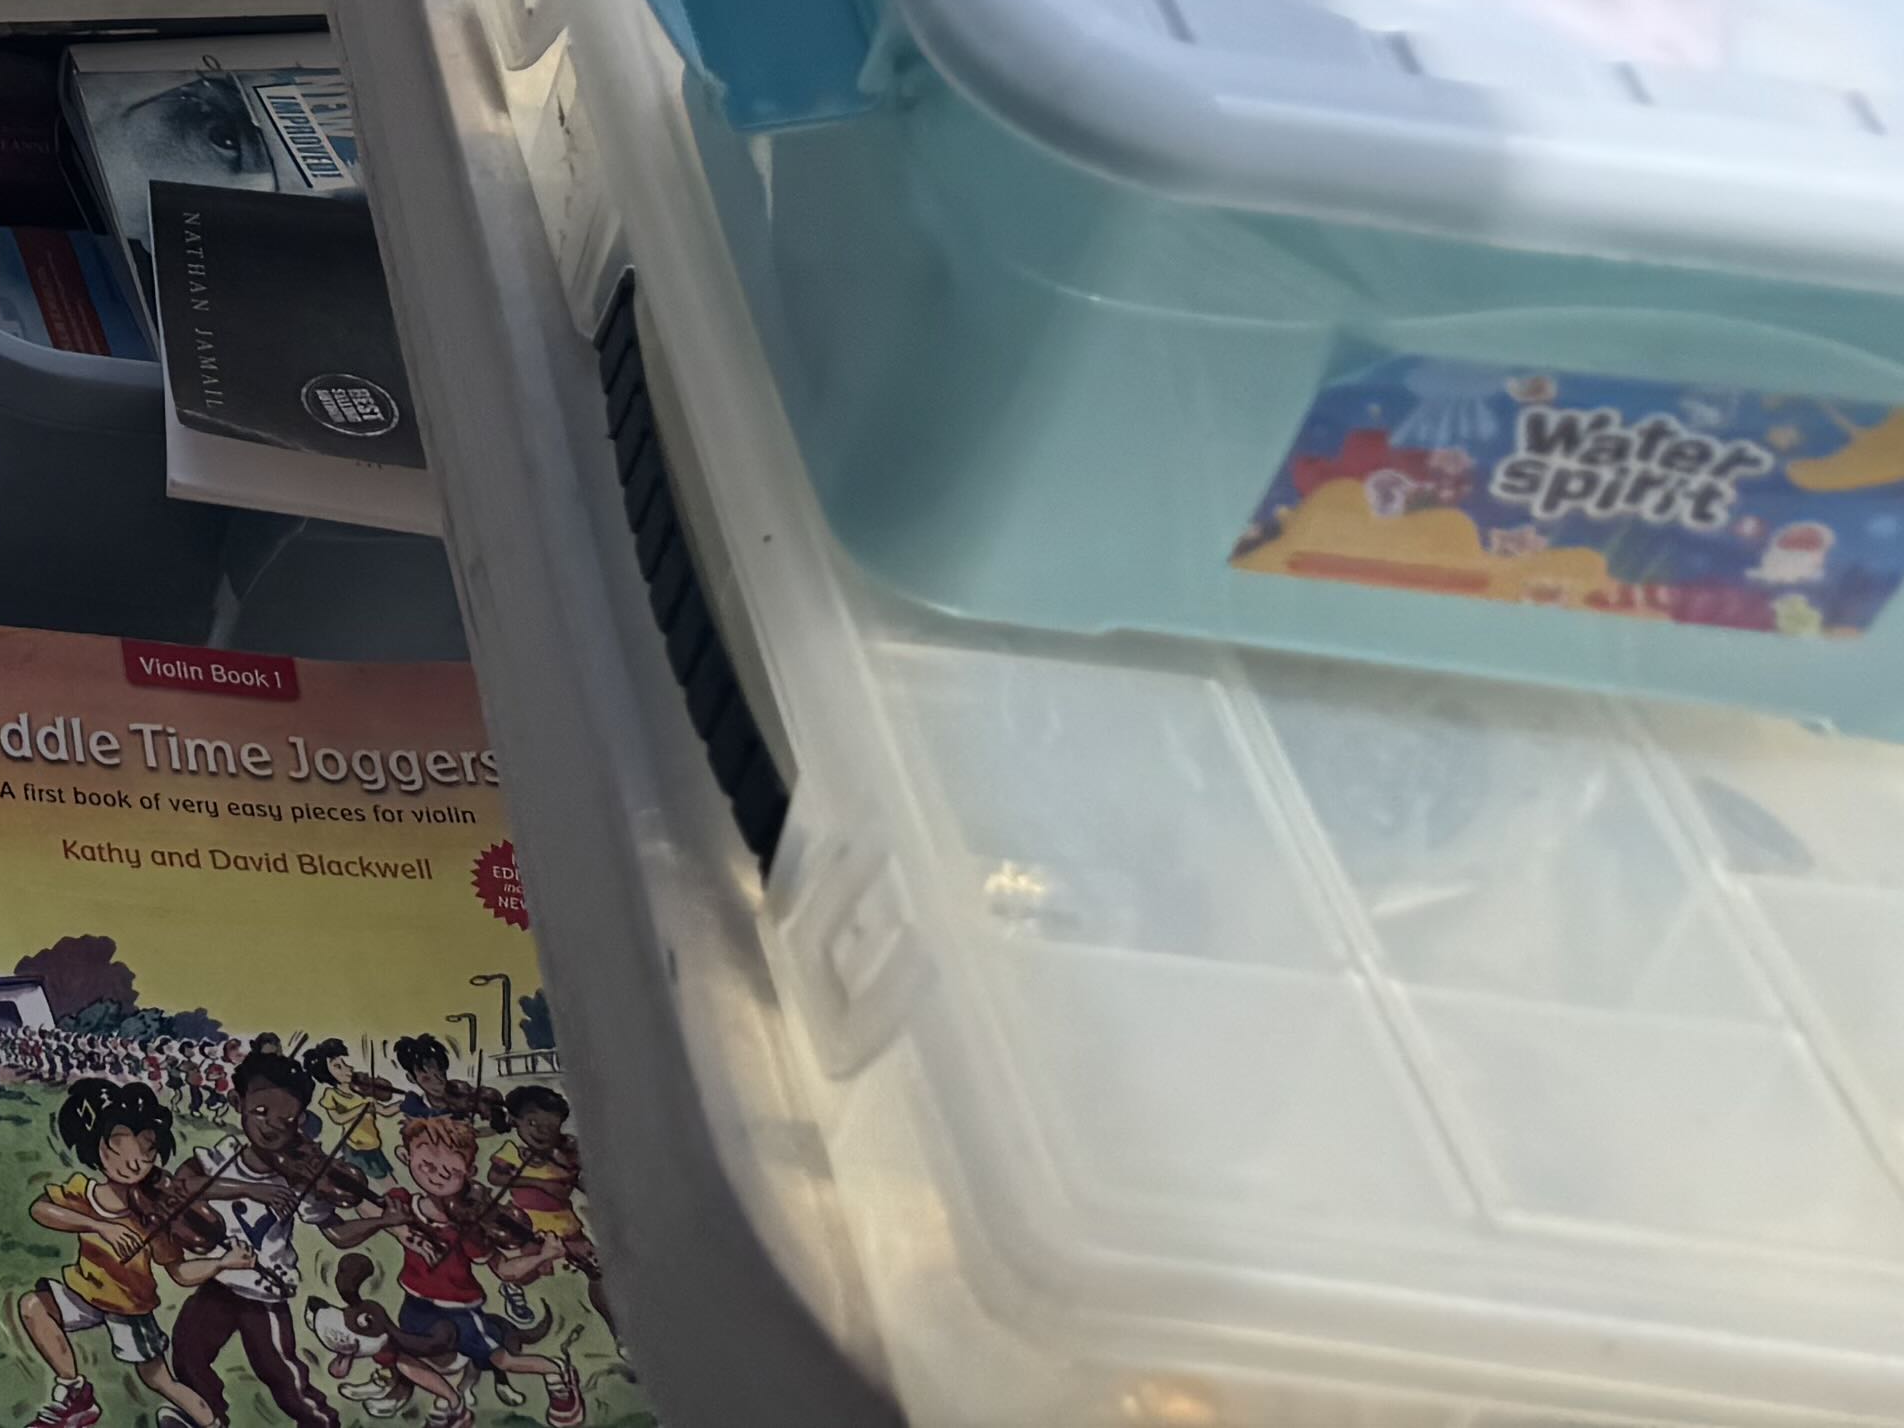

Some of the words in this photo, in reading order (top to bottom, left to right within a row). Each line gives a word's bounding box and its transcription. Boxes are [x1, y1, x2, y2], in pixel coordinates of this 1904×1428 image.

[181, 211, 211, 314] NATHAN
[192, 325, 224, 410] JAMAIL
[347, 387, 385, 423] BEST
[1519, 408, 1778, 494] Water
[1490, 448, 1740, 528] spirit
[138, 655, 205, 686] Violin
[208, 662, 273, 690] Book
[128, 722, 276, 781] Time
[286, 736, 501, 795] Joggers
[22, 781, 67, 809] first
[71, 785, 133, 811] book
[139, 789, 163, 812] of
[168, 796, 221, 819] very
[225, 800, 283, 823] easy
[290, 800, 365, 827] pieces
[372, 801, 406, 825] for
[410, 802, 477, 827] violin
[60, 837, 143, 870] Kathy
[150, 845, 203, 870] and
[210, 844, 289, 876] David
[297, 851, 433, 883] Blackwell
